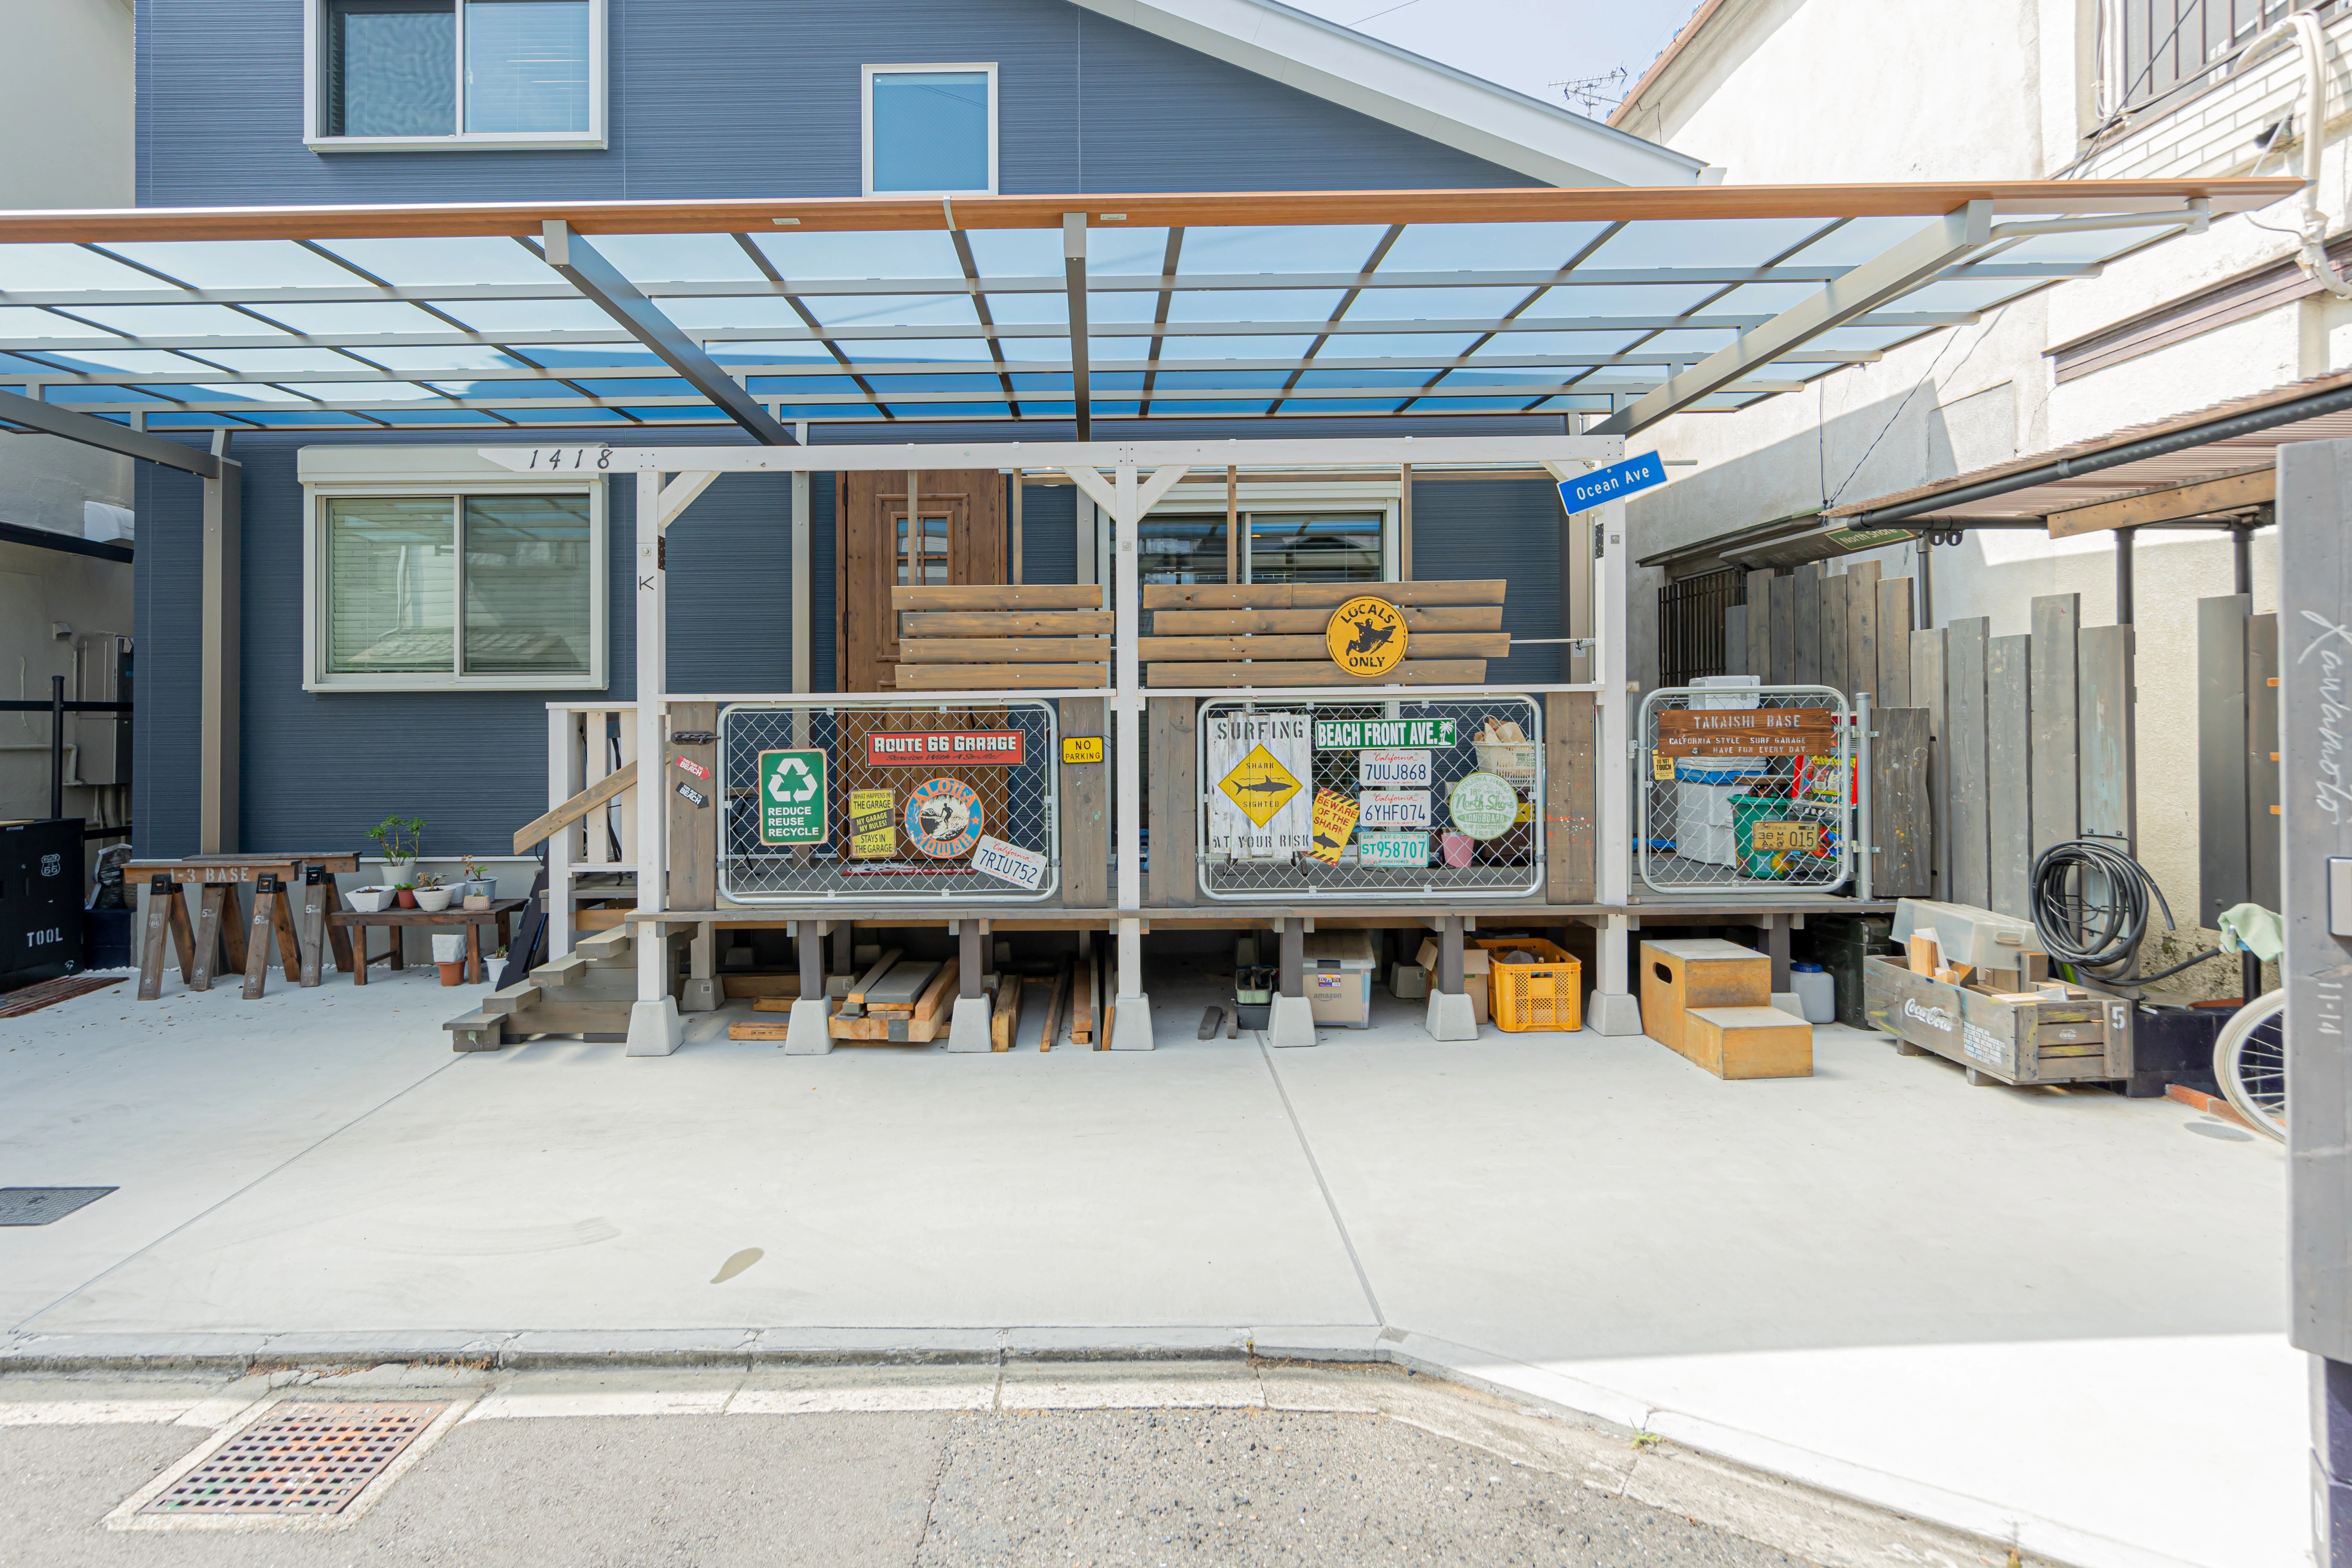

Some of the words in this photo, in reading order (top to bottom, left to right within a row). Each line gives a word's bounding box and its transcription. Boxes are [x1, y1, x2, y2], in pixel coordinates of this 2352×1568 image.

[530, 449, 613, 470] 1418
[1576, 478, 1619, 500] Ocean
[1625, 467, 1649, 484] Ave
[1839, 533, 1870, 544] North
[640, 576, 654, 590] K
[1340, 604, 1395, 624] LOCALS
[1349, 656, 1385, 667] ONLY
[1694, 716, 1755, 729] TAKAISHI
[1767, 714, 1801, 728] BASE
[1217, 721, 1303, 740] SURFING
[1318, 723, 1360, 746] BEACH
[1365, 722, 1406, 745] FRONT
[1410, 722, 1438, 745] AVE.
[927, 736, 949, 751] 66
[1075, 740, 1091, 750] NO
[1066, 752, 1100, 760] PARKING
[1375, 753, 1418, 763] California
[680, 762, 702, 776] BEACH
[1365, 764, 1426, 780] 7UUJ868
[1490, 777, 1511, 793] HAWAII
[680, 787, 701, 805] BEACH
[913, 780, 976, 807] ALOHA
[1375, 793, 1418, 804] California
[854, 801, 865, 809] THE
[866, 800, 891, 808] GARAGE
[1317, 796, 1357, 819] BEWARE
[1455, 793, 1485, 811] North
[1484, 794, 1515, 811] Shore
[768, 807, 811, 816] REDUCE
[866, 812, 887, 823] GARAGE
[1317, 807, 1330, 816] OF
[1332, 812, 1350, 827] THE
[1366, 805, 1425, 821] 6YHF074
[1464, 814, 1504, 823] LONGBOARD
[768, 817, 804, 826] REUSE
[869, 820, 887, 830] RULES!
[1314, 817, 1346, 835] SHARK
[769, 827, 819, 836] RECYCLE
[861, 834, 878, 843] STAYS
[879, 834, 885, 842] IN
[1790, 831, 1813, 847] 015
[855, 845, 867, 853] THE
[867, 844, 892, 853] GARAGE
[1213, 836, 1230, 848] AT
[1238, 836, 1271, 848] YOUR
[1280, 834, 1309, 847] RISK
[993, 843, 1033, 863] California
[44, 866, 58, 874] 66
[980, 849, 1037, 884] 7RIU752
[206, 867, 249, 882] BASE
[987, 869, 1020, 883] dmv.ca.gov
[27, 927, 63, 947] TOOL
[2112, 1006, 2125, 1029] 5
